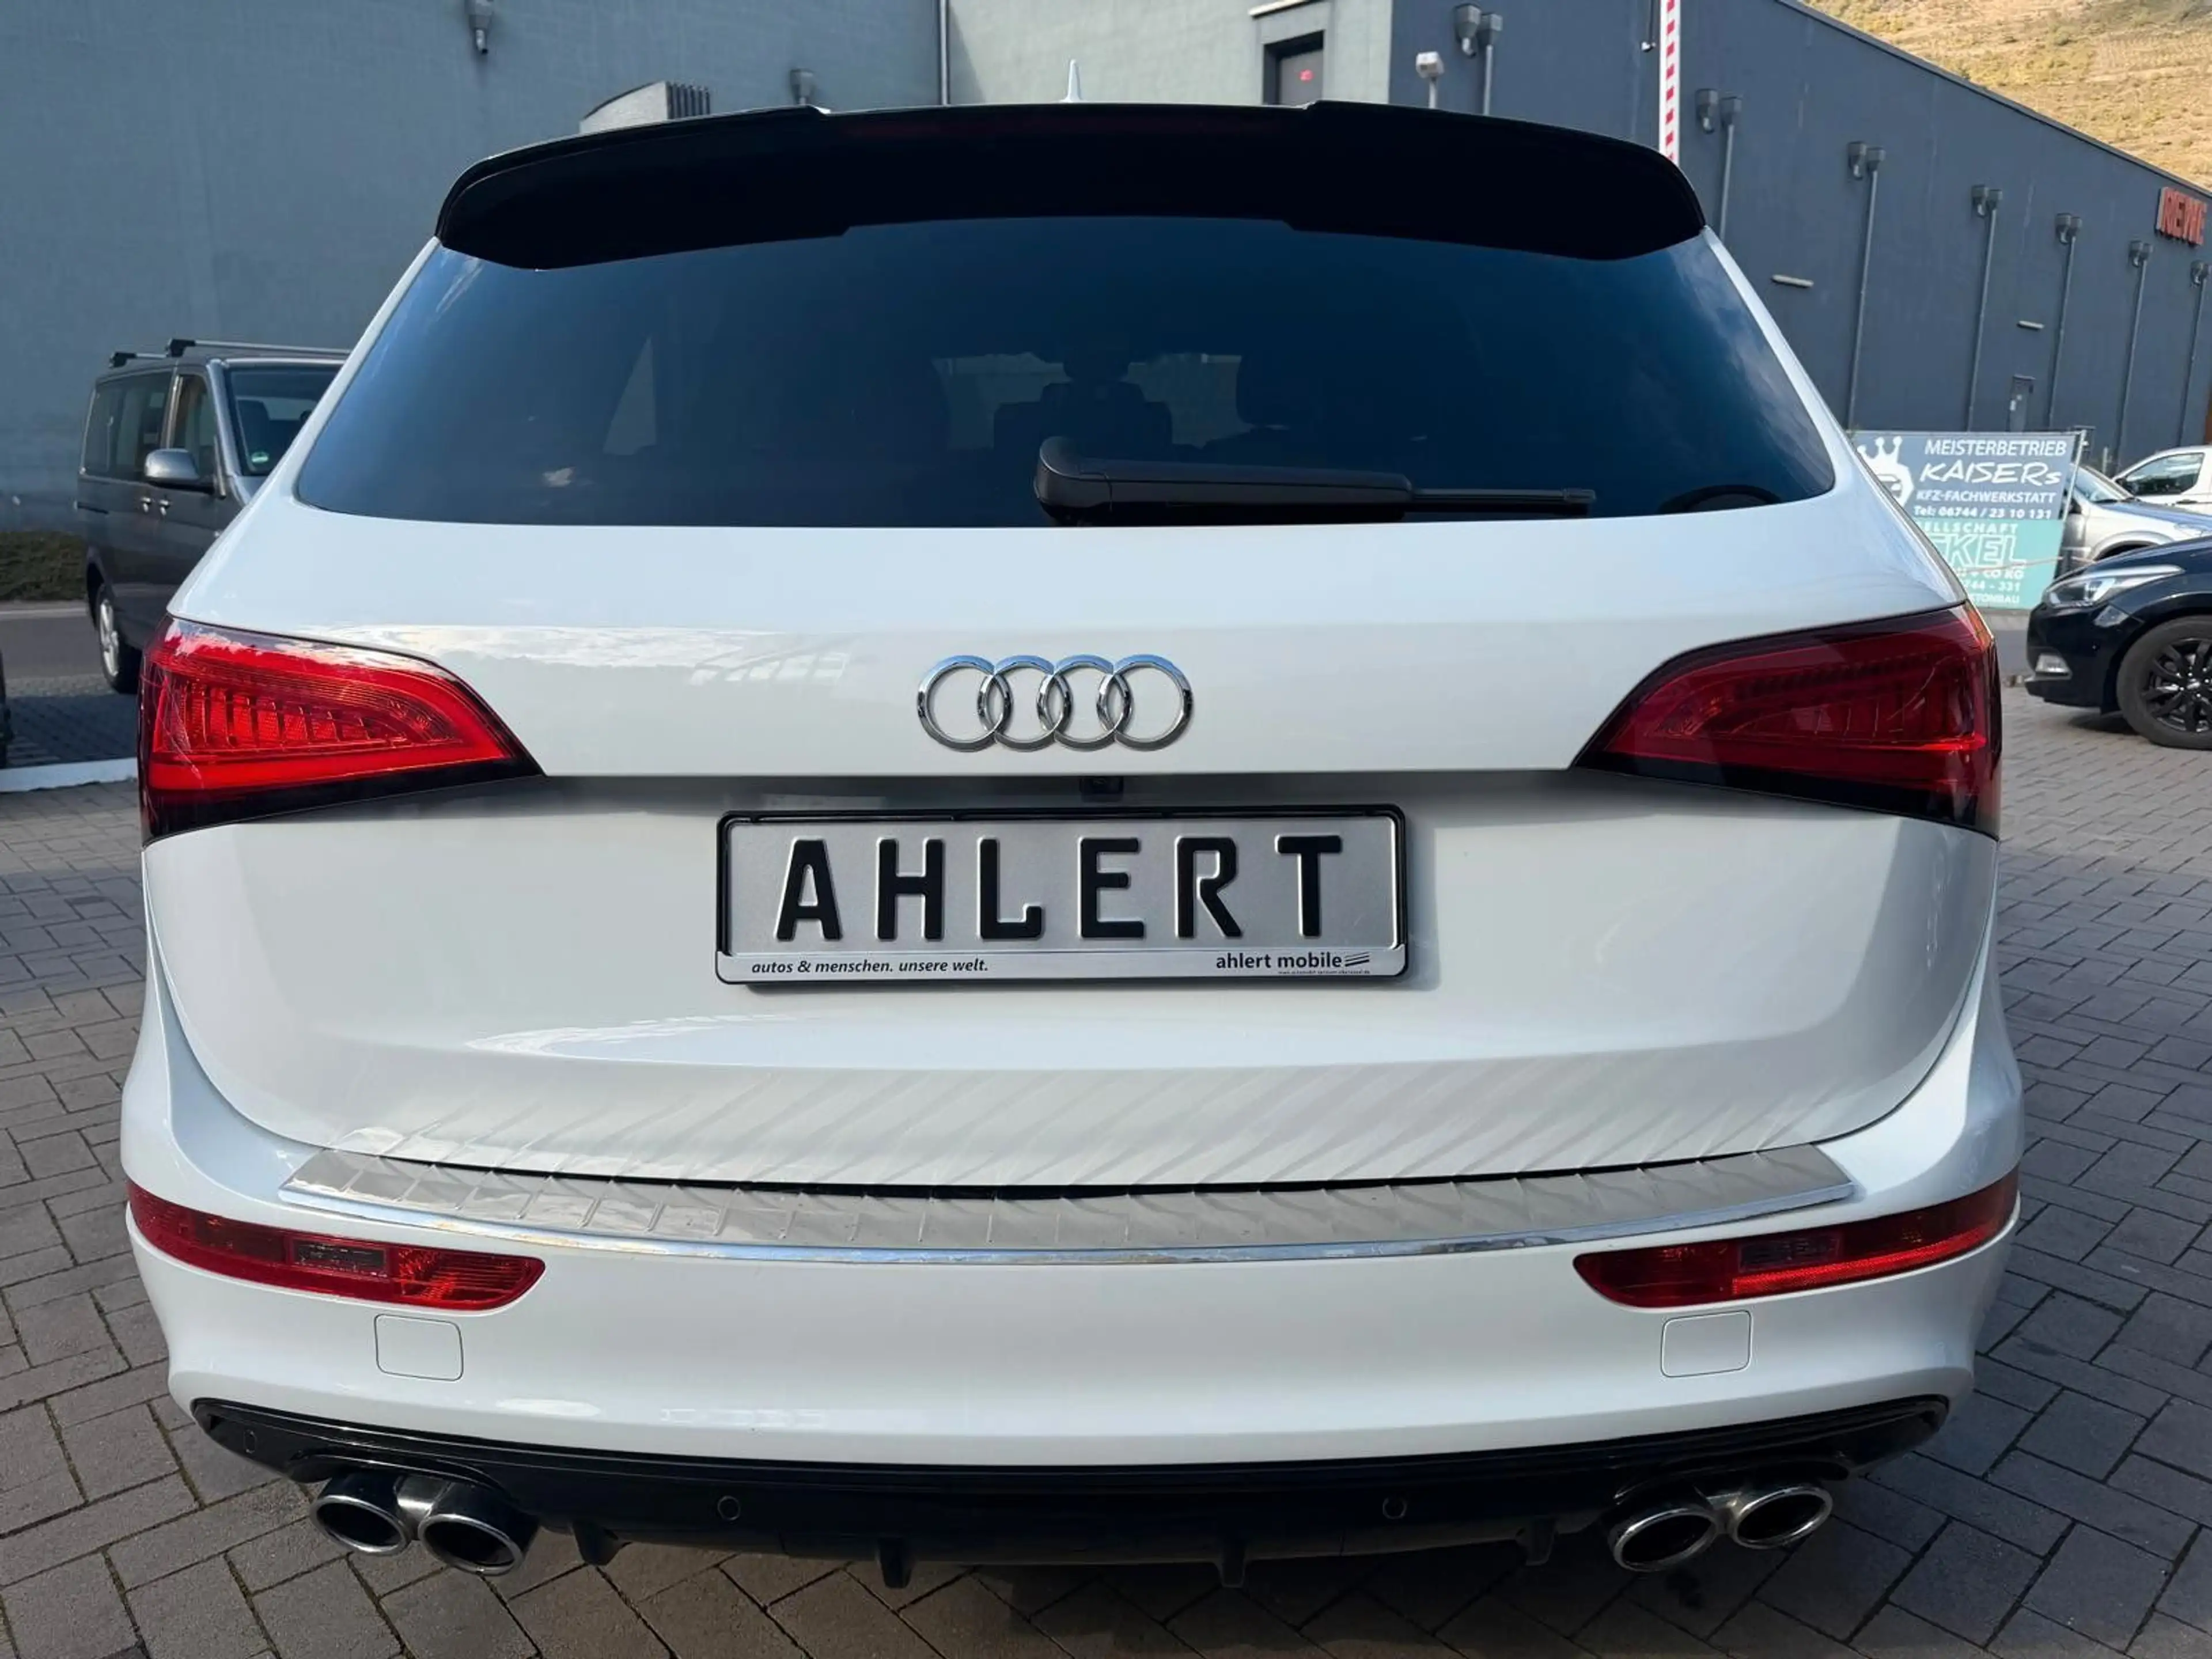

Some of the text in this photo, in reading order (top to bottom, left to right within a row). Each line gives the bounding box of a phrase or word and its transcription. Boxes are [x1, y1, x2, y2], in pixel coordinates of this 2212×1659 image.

[2158, 187, 2207, 246] REWE
[1925, 439, 2067, 456] MEISTERBETRIEB
[1916, 490, 2056, 503] KFZ-FACHWERKSTATT
[1988, 508, 2005, 518] 23
[2010, 509, 2025, 518] 10
[2029, 509, 2052, 519] 131
[776, 836, 1343, 940] AHLERT
[752, 959, 988, 973] autos & menschen. unsere welt.
[1216, 952, 1342, 968] ahlert mobile
